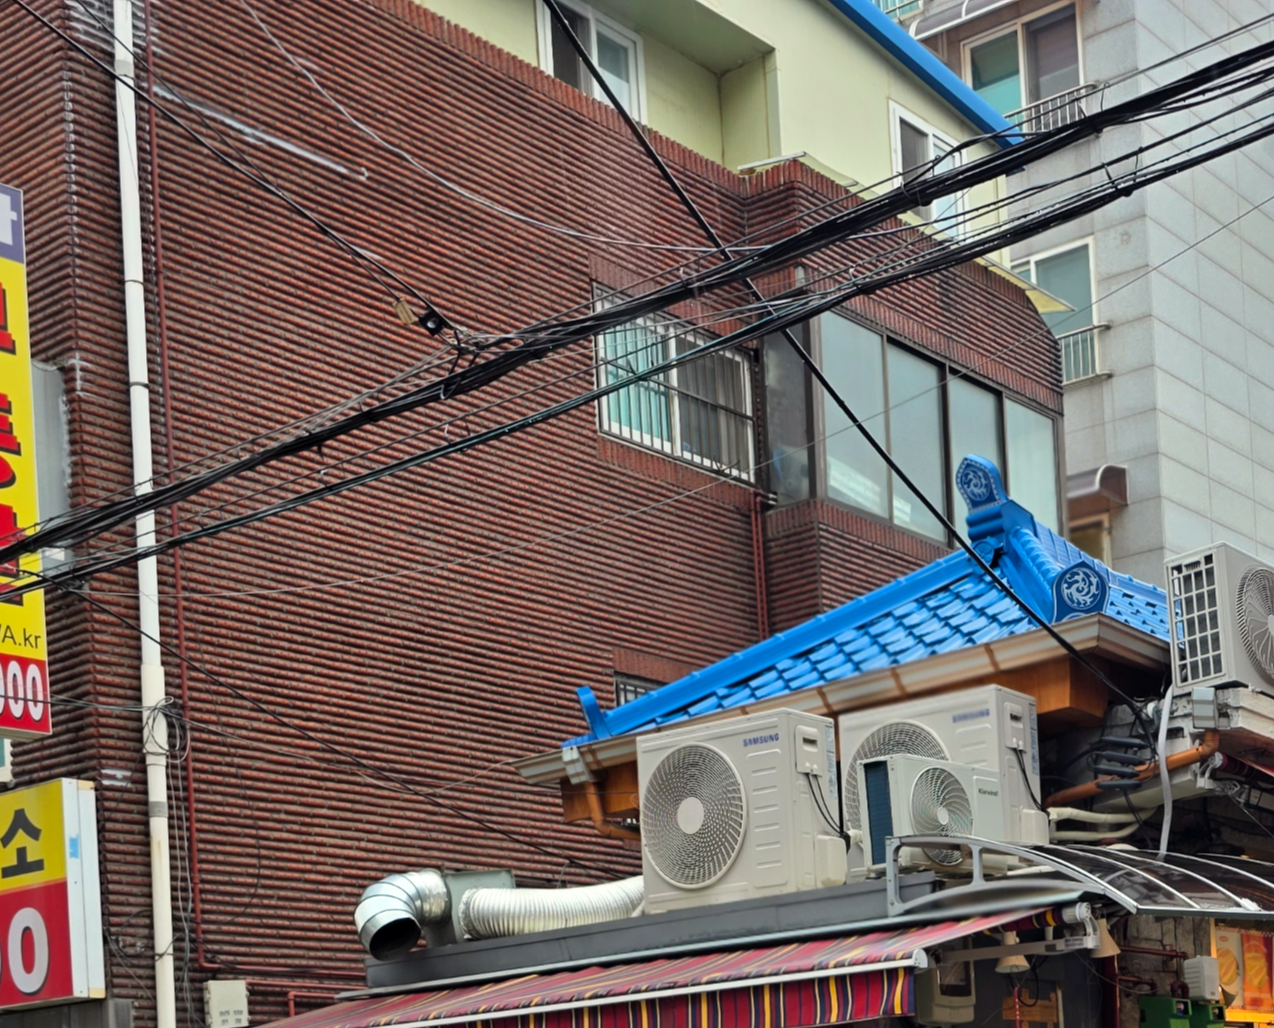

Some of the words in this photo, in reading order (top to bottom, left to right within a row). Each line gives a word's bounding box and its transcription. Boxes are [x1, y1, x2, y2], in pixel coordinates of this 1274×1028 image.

[0, 622, 41, 649] A.kr
[0, 659, 44, 722] 00
[952, 708, 991, 724] SAMSUNG
[743, 733, 780, 747] SAMSUNG
[0, 907, 50, 994] 0
